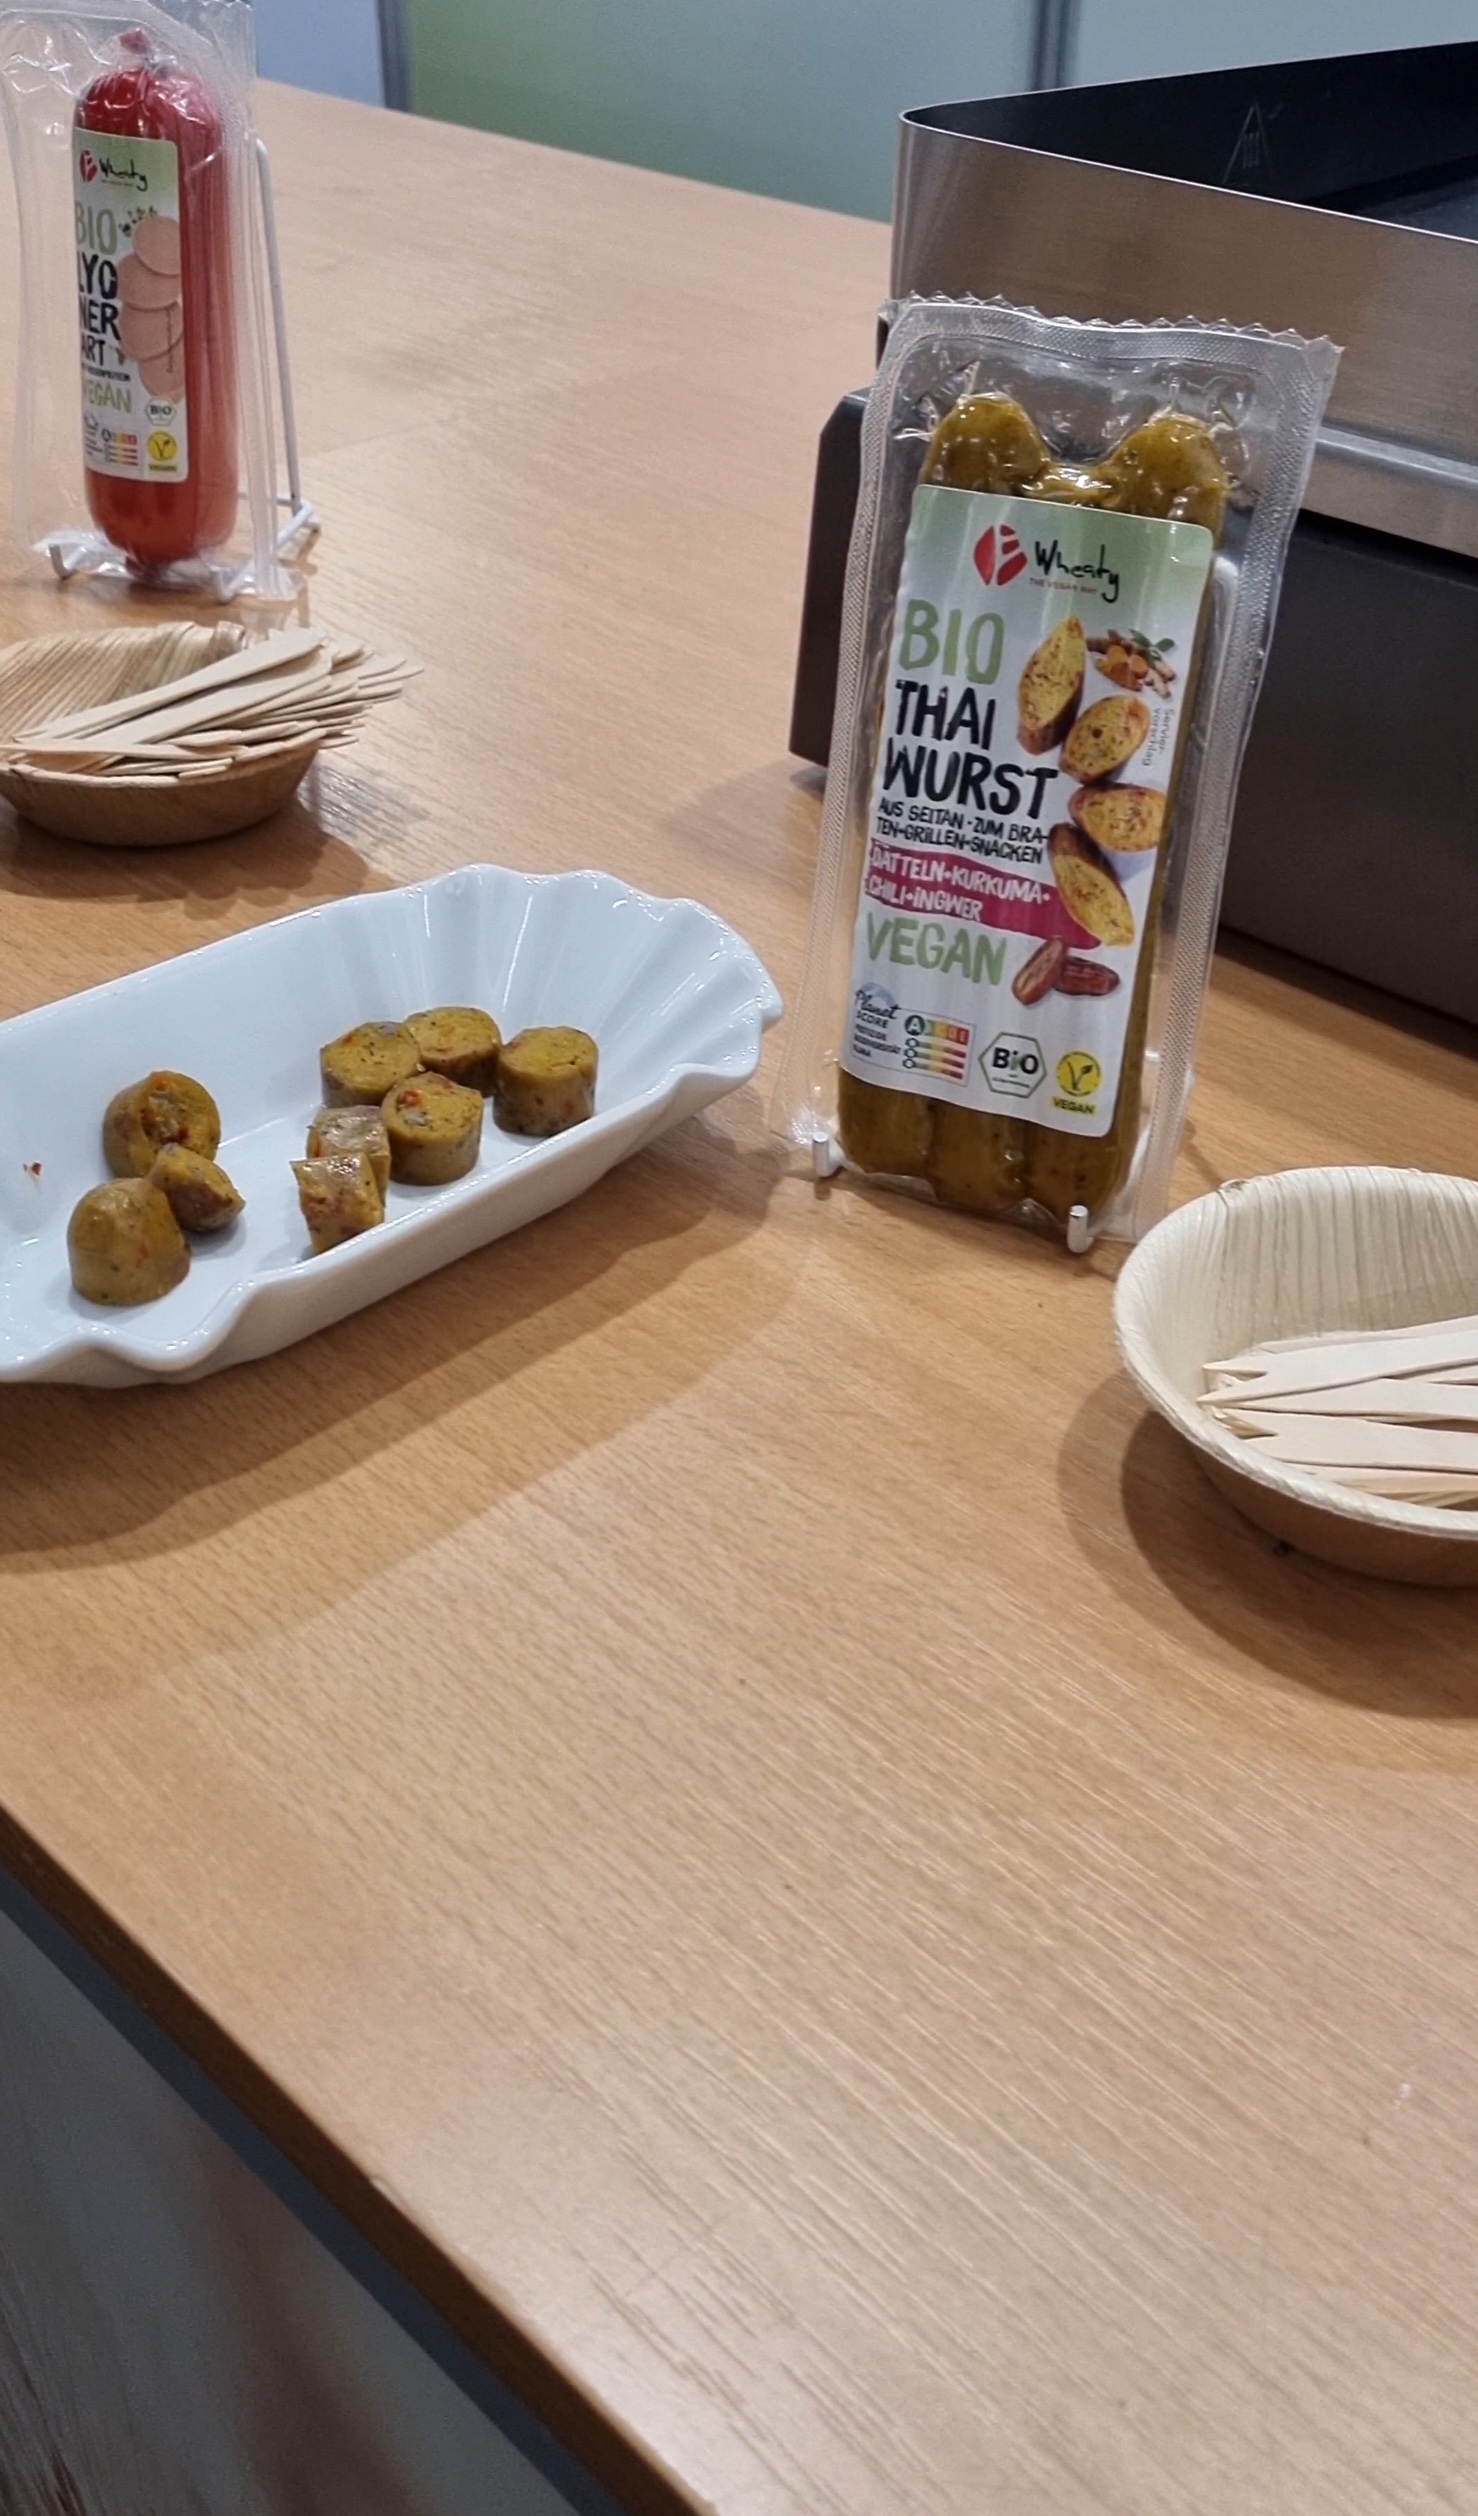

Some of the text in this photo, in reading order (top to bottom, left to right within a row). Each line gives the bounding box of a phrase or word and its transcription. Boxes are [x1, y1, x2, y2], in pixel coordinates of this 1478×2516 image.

[75, 201, 118, 255] BIO
[1035, 540, 1120, 603] Wheaty
[900, 599, 1005, 685] BIO
[896, 680, 996, 750] THAI
[883, 739, 1058, 819] WURST
[878, 797, 1051, 844] AUS SEITAN ZUM BRA-
[865, 912, 1007, 987] VEGAN
[1052, 1096, 1096, 1115] VEGAN
